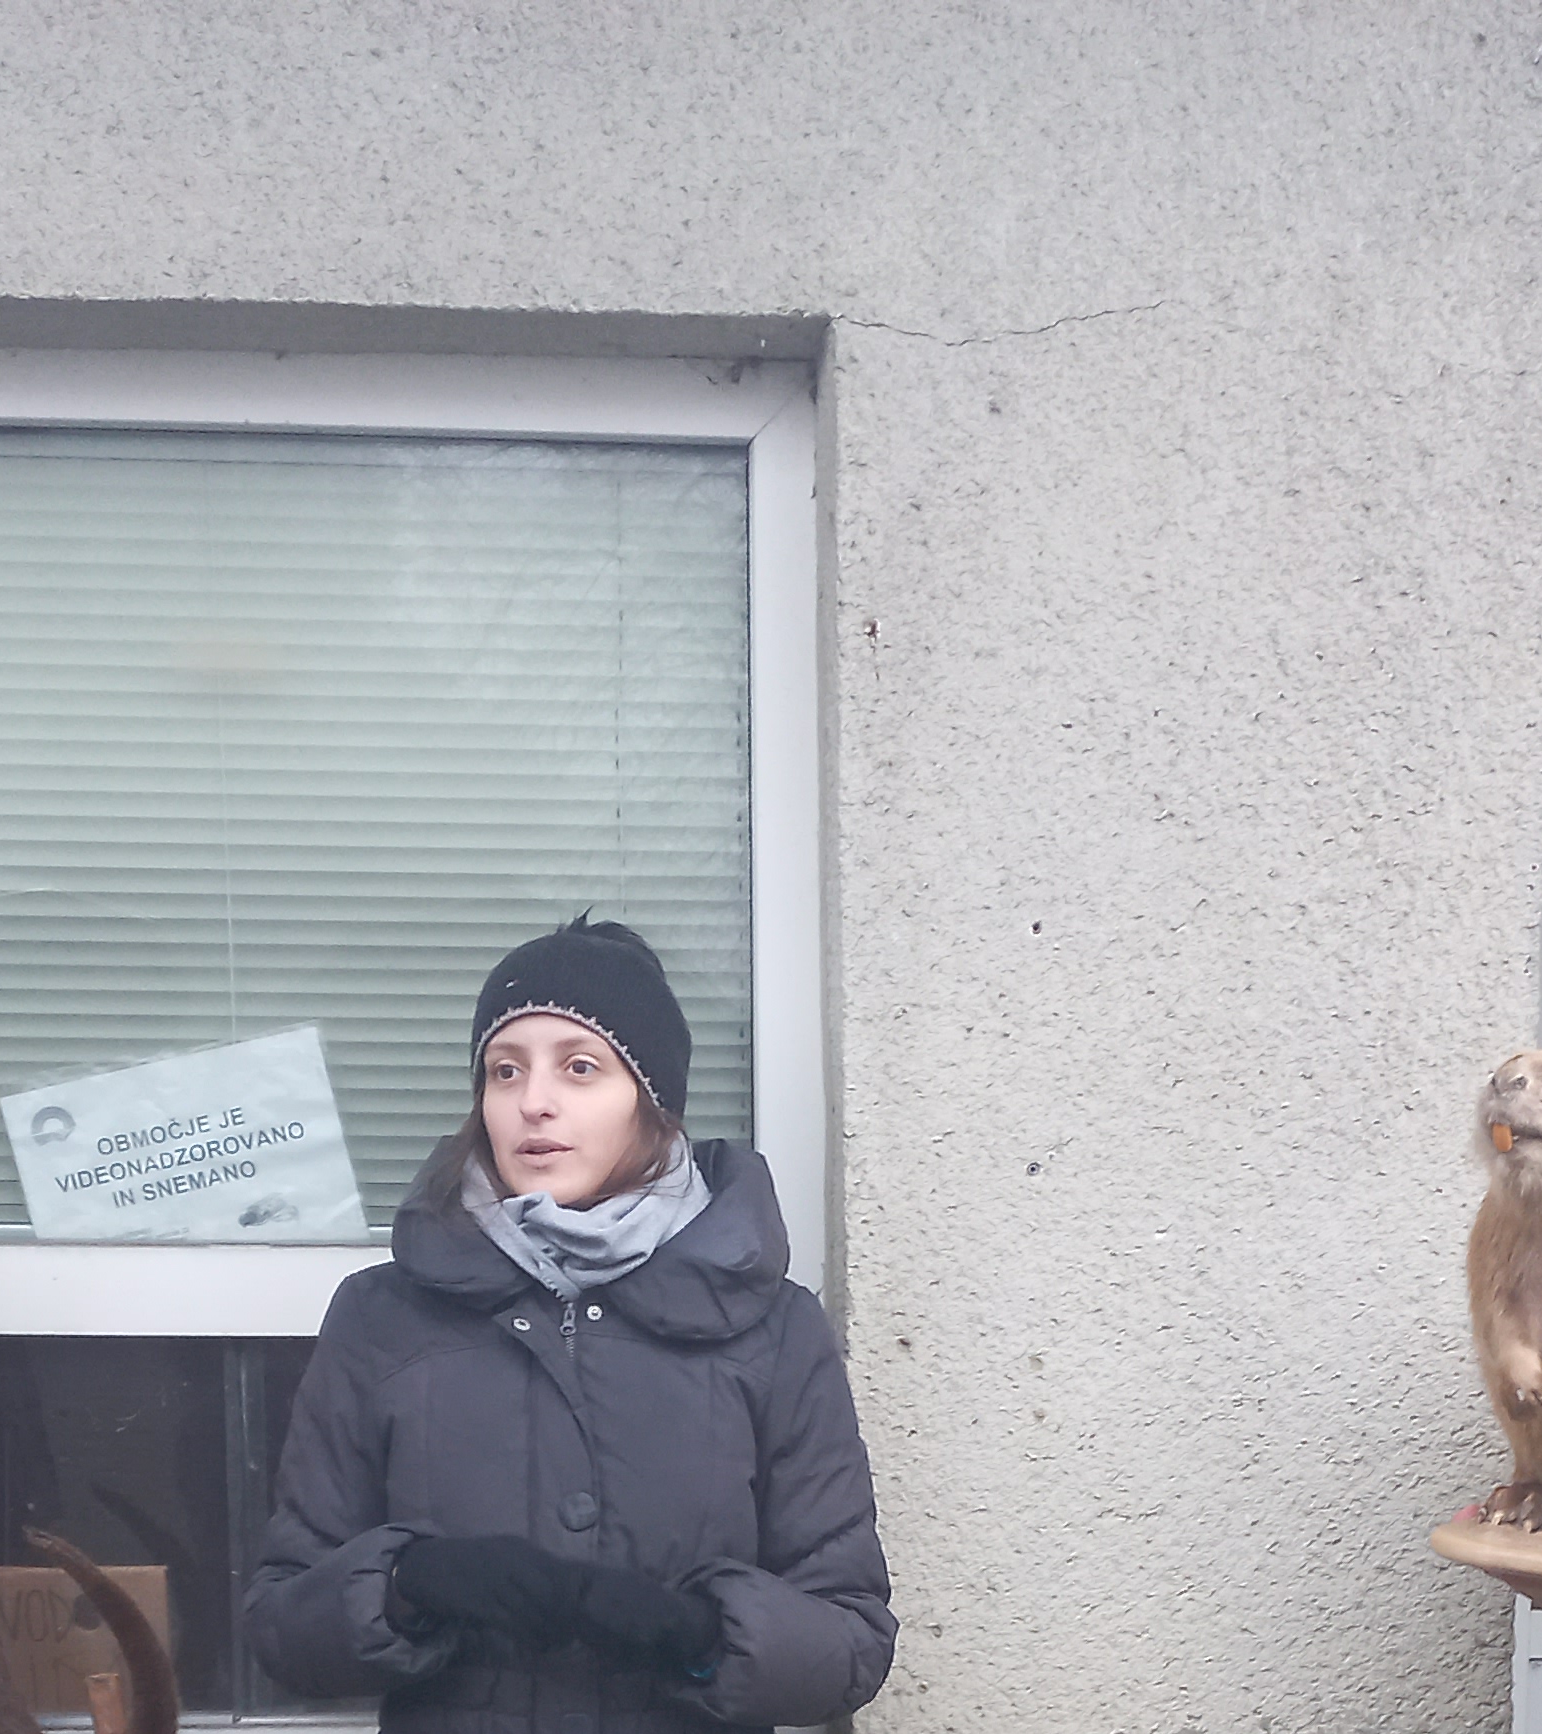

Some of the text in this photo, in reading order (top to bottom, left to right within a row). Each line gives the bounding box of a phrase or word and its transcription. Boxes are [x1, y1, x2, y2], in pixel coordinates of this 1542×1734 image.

[96, 1107, 245, 1156] OBMOČJE JE
[54, 1120, 306, 1193] VIDEONADZOROVANO
[112, 1160, 258, 1209] IN SNEMANO
